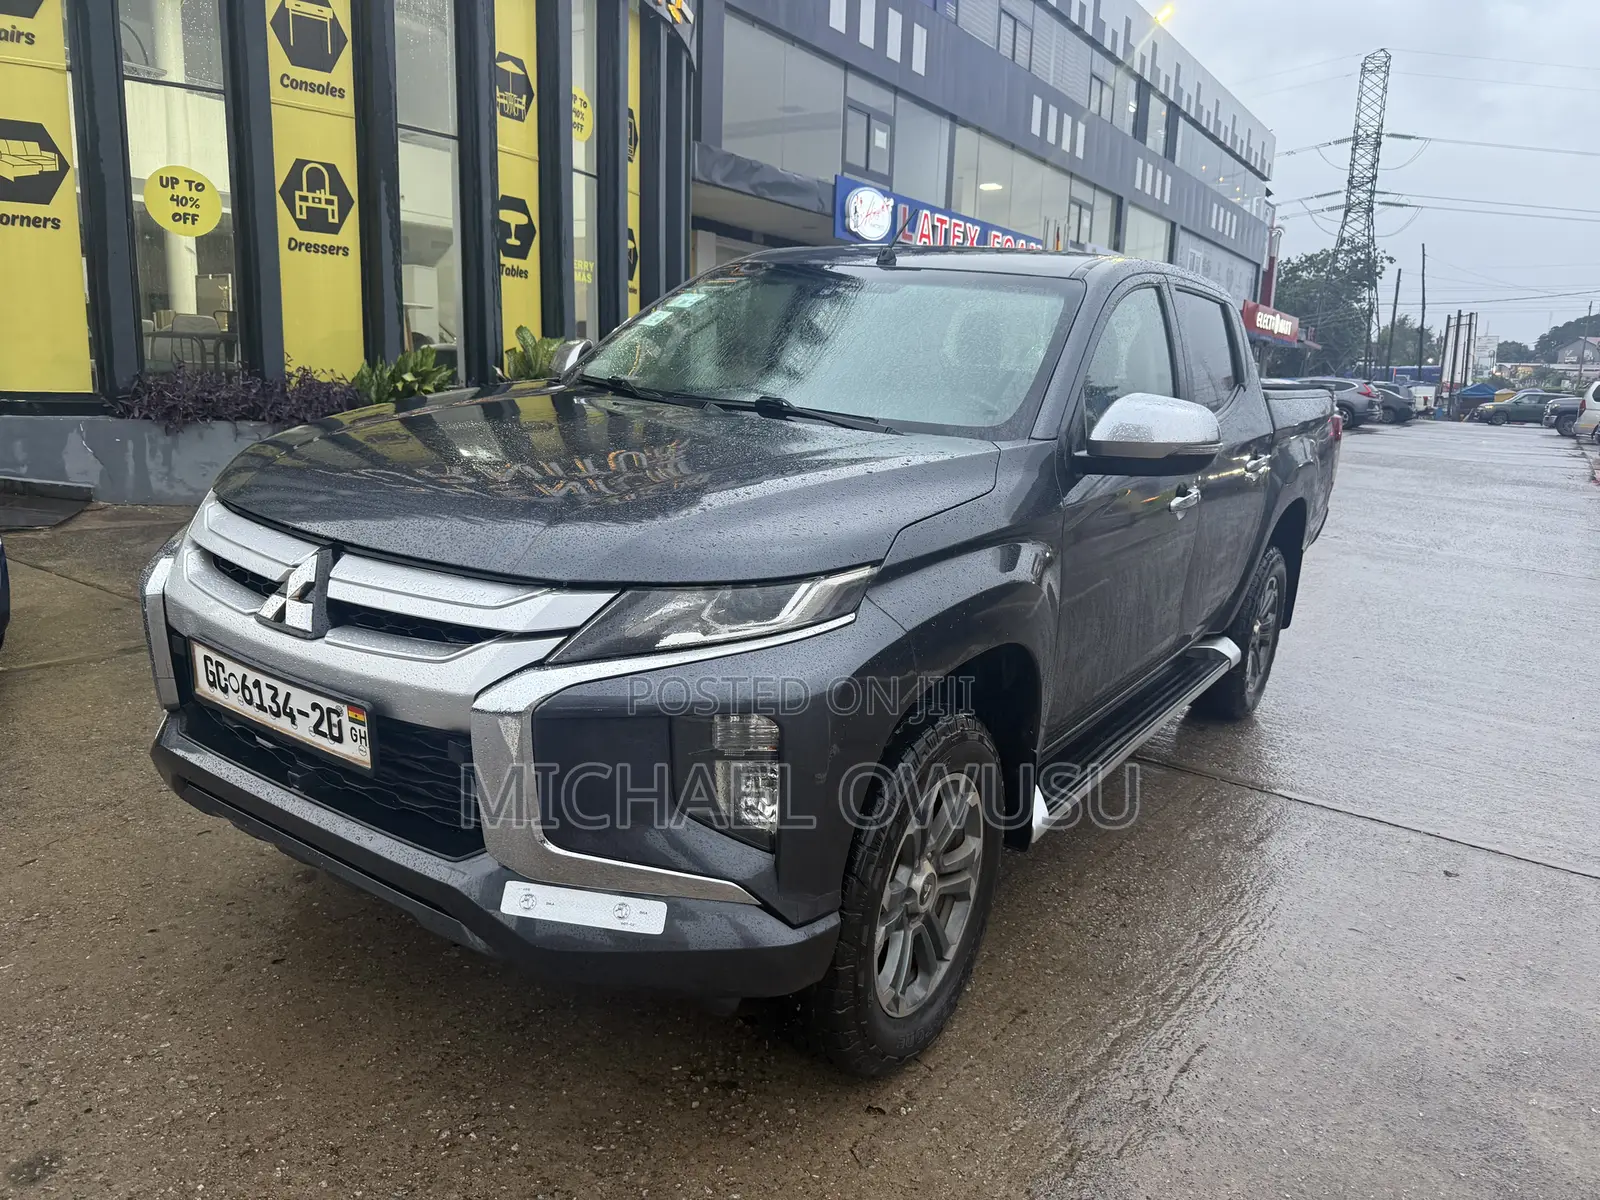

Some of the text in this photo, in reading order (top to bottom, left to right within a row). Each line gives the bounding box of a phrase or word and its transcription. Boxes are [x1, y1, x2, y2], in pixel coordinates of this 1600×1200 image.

[279, 73, 346, 99] Consoles
[579, 97, 588, 109] TO
[159, 175, 206, 193] UP TO
[169, 193, 201, 210] 40%
[171, 212, 200, 226] OFF
[900, 204, 980, 247] LATEX
[287, 237, 350, 258] Dressers
[500, 263, 529, 279] Tables
[241, 673, 344, 744] 6134-20
[350, 727, 369, 748] GH
